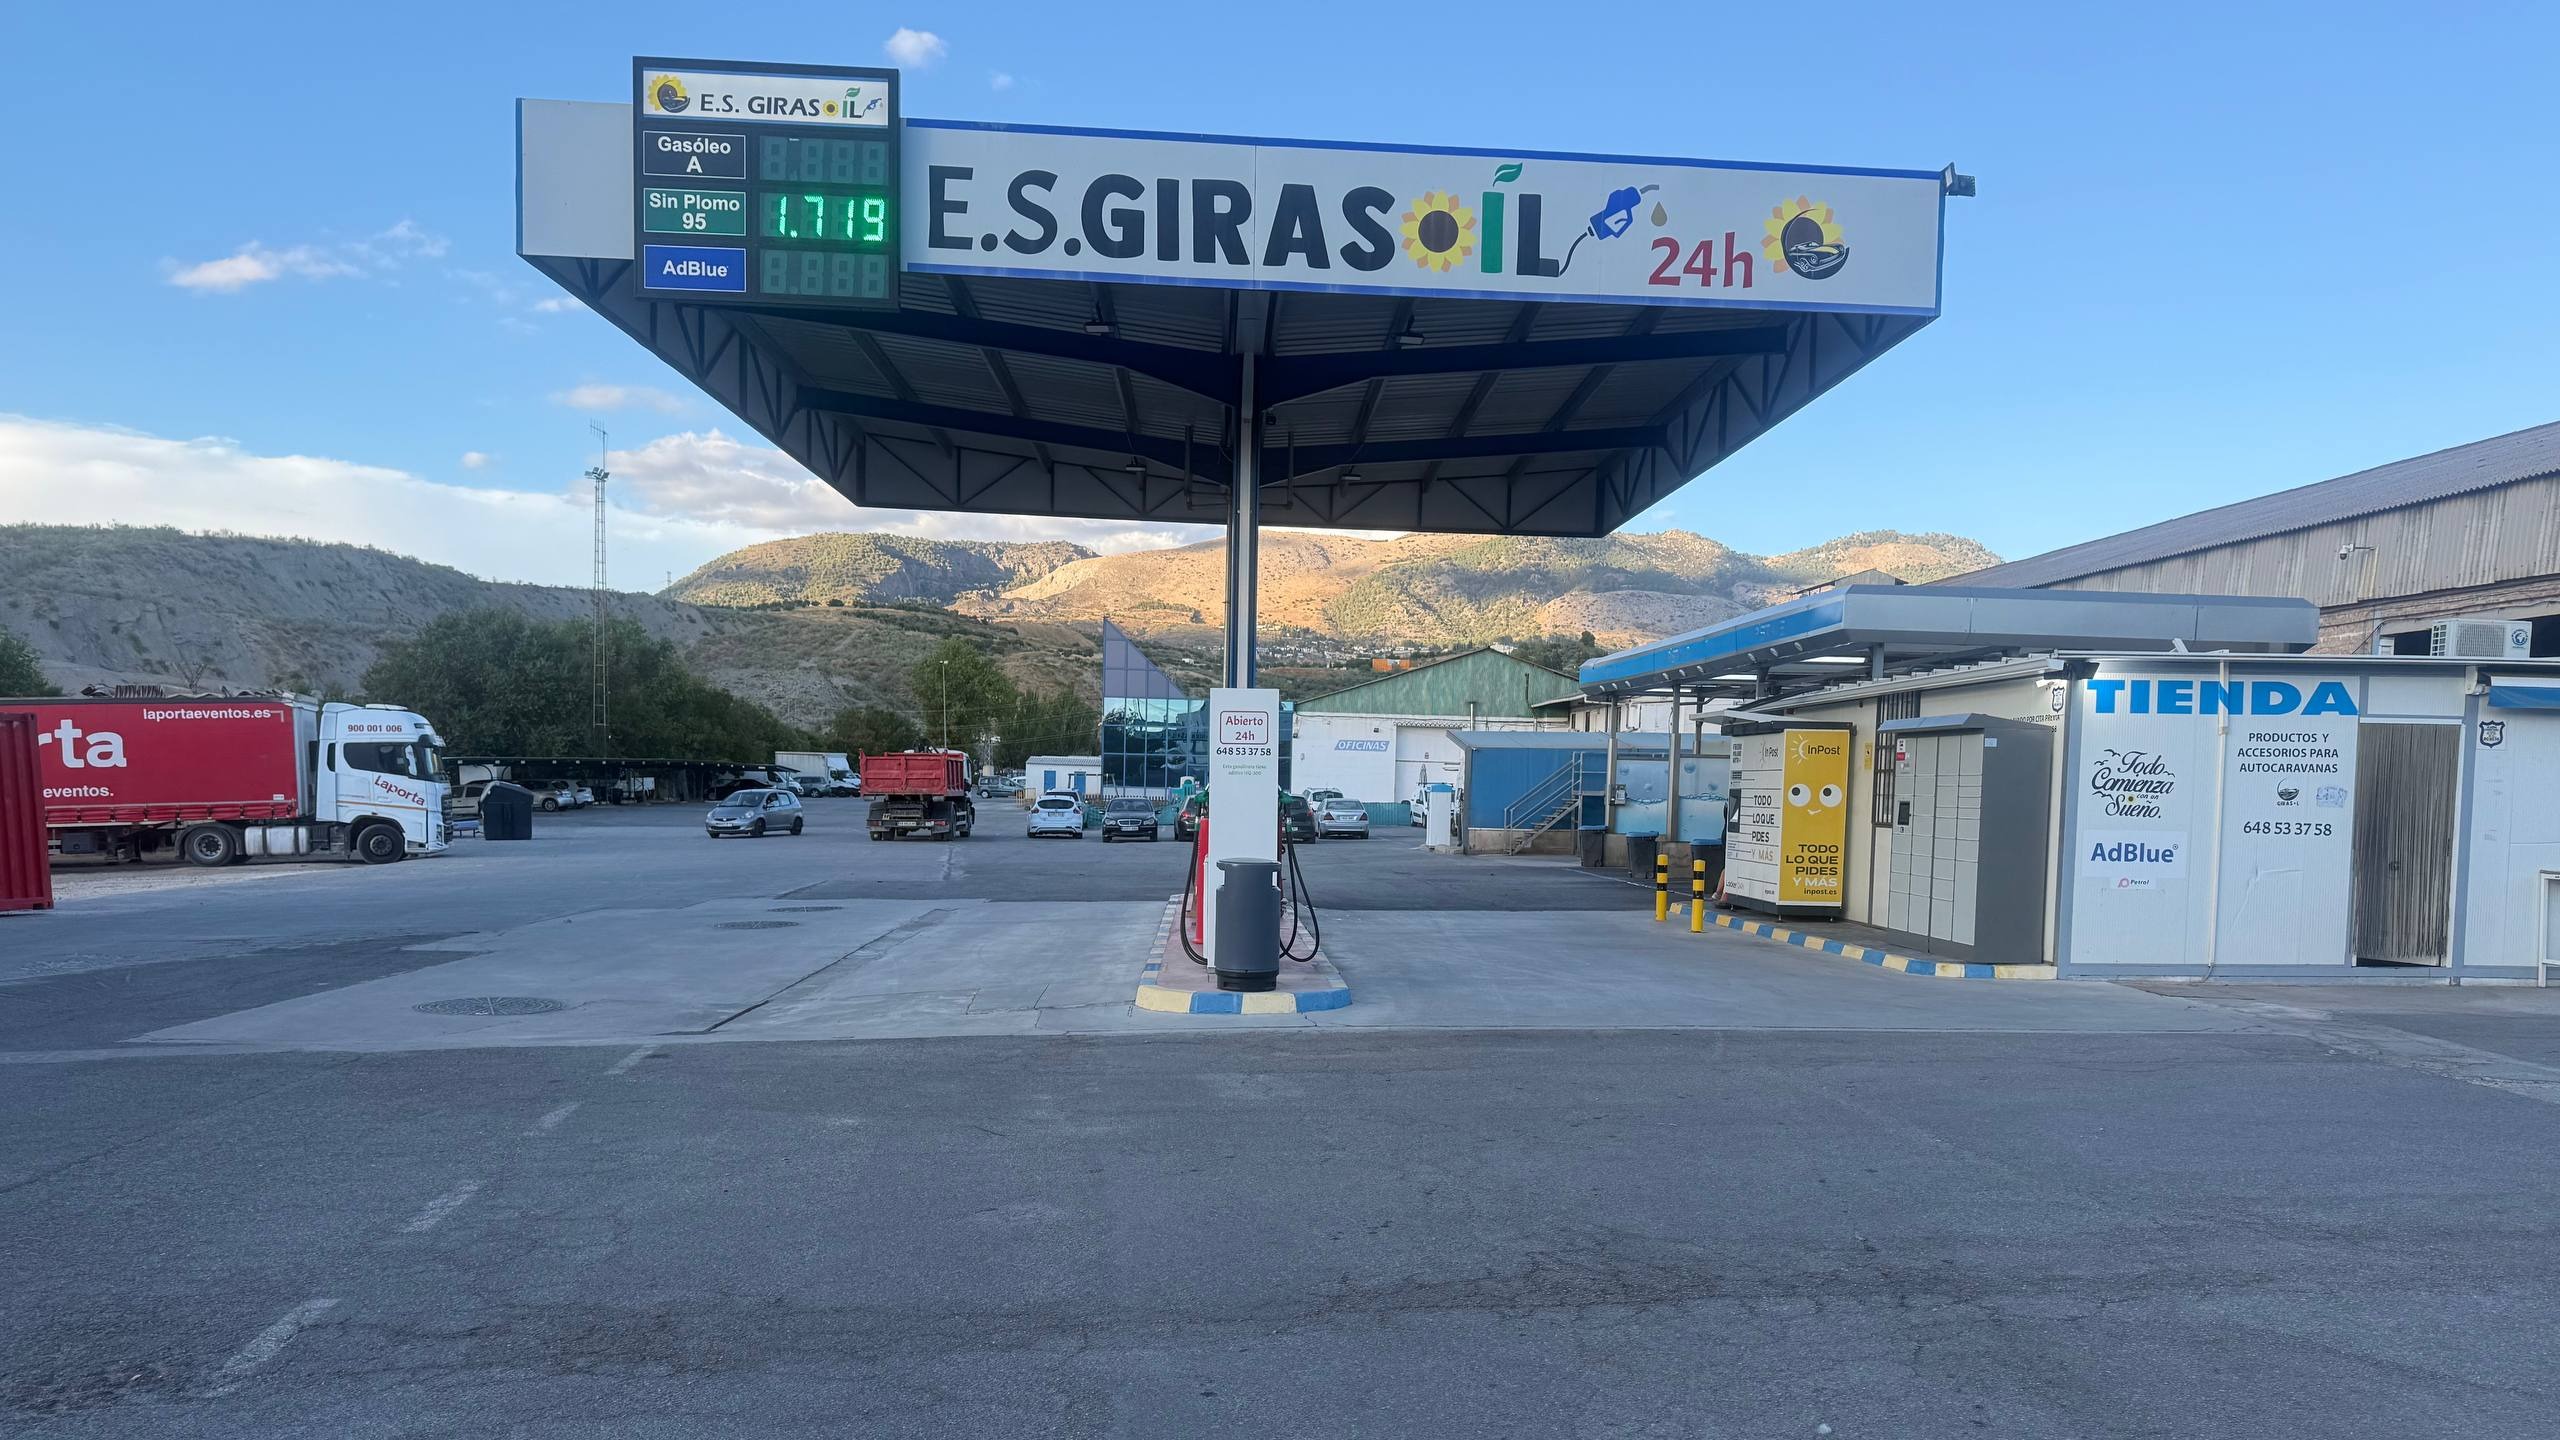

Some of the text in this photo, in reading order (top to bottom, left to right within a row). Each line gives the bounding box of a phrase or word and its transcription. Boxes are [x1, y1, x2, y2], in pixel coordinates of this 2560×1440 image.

[700, 93, 740, 113] E.S.
[657, 136, 731, 154] Gasóleo
[686, 156, 703, 174] A
[649, 192, 740, 211] Sin Plomo
[682, 212, 707, 230] 95
[779, 196, 885, 241] 1.719
[1647, 231, 1754, 288] 24h
[2087, 679, 2359, 715] TIENDA
[143, 708, 272, 722] laportaeventos.es
[1225, 715, 1264, 726] Abierto
[347, 724, 402, 733] 900 001 006
[1235, 731, 1255, 741] 24h
[2248, 733, 2329, 743] PRODUCTOS Y
[1216, 747, 1272, 756] 648 53 37 58
[1338, 741, 1387, 751] OFICINAS
[1807, 744, 1841, 756] InPost
[2237, 748, 2339, 758] ACCESORIOS PARA
[2117, 751, 2165, 777] Todo
[2239, 763, 2338, 773] AUTOCARAVANAS
[2092, 767, 2174, 794] Comienza
[374, 775, 425, 806] Laporta
[1754, 795, 1772, 806] TODO
[2105, 794, 2161, 819] Sueño.
[2243, 821, 2332, 836] 648 53 37 58
[1799, 844, 1839, 853] TODO
[1786, 855, 1839, 865] LO QUE
[1795, 866, 1838, 876] PIDES
[1792, 875, 1838, 887] Y MÁS
